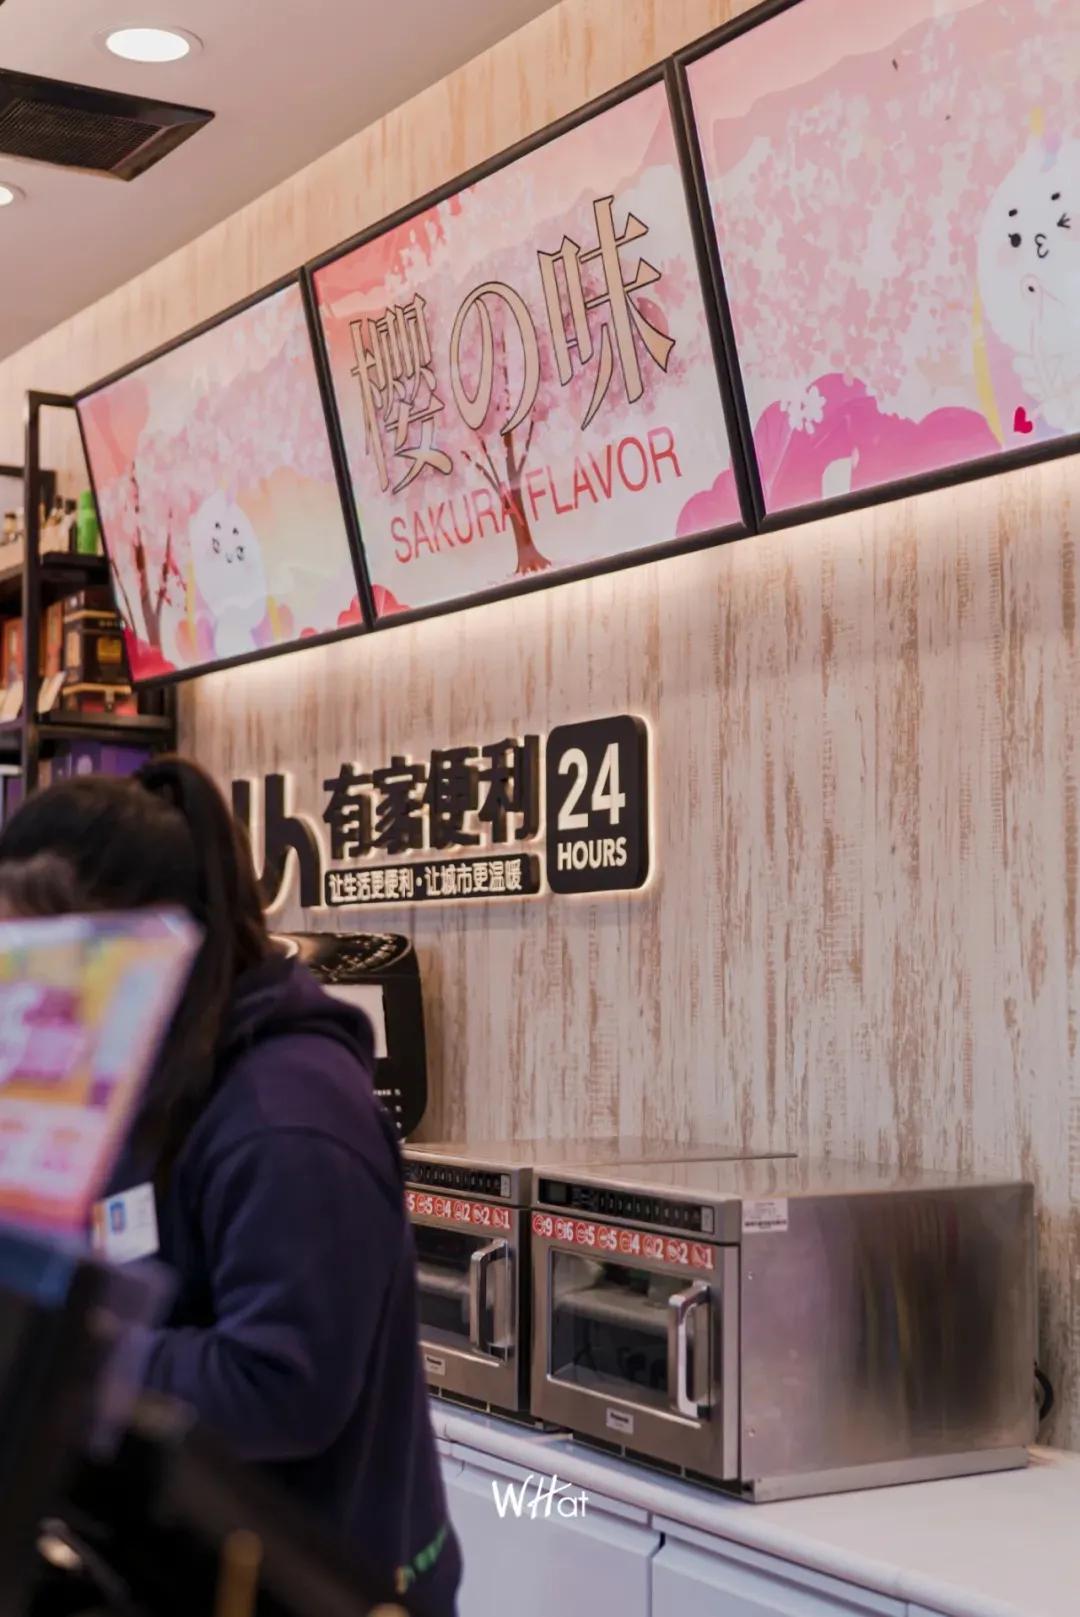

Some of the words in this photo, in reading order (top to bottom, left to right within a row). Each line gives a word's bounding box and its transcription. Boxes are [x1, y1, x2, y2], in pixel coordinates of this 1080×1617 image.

[390, 486, 525, 563] SAKURA
[525, 426, 682, 520] FLAVOR
[323, 734, 541, 859] 有家便利
[557, 743, 627, 831] 24
[328, 858, 523, 903] 让生活更便利·让城市更温暖
[557, 836, 627, 871] HOURS
